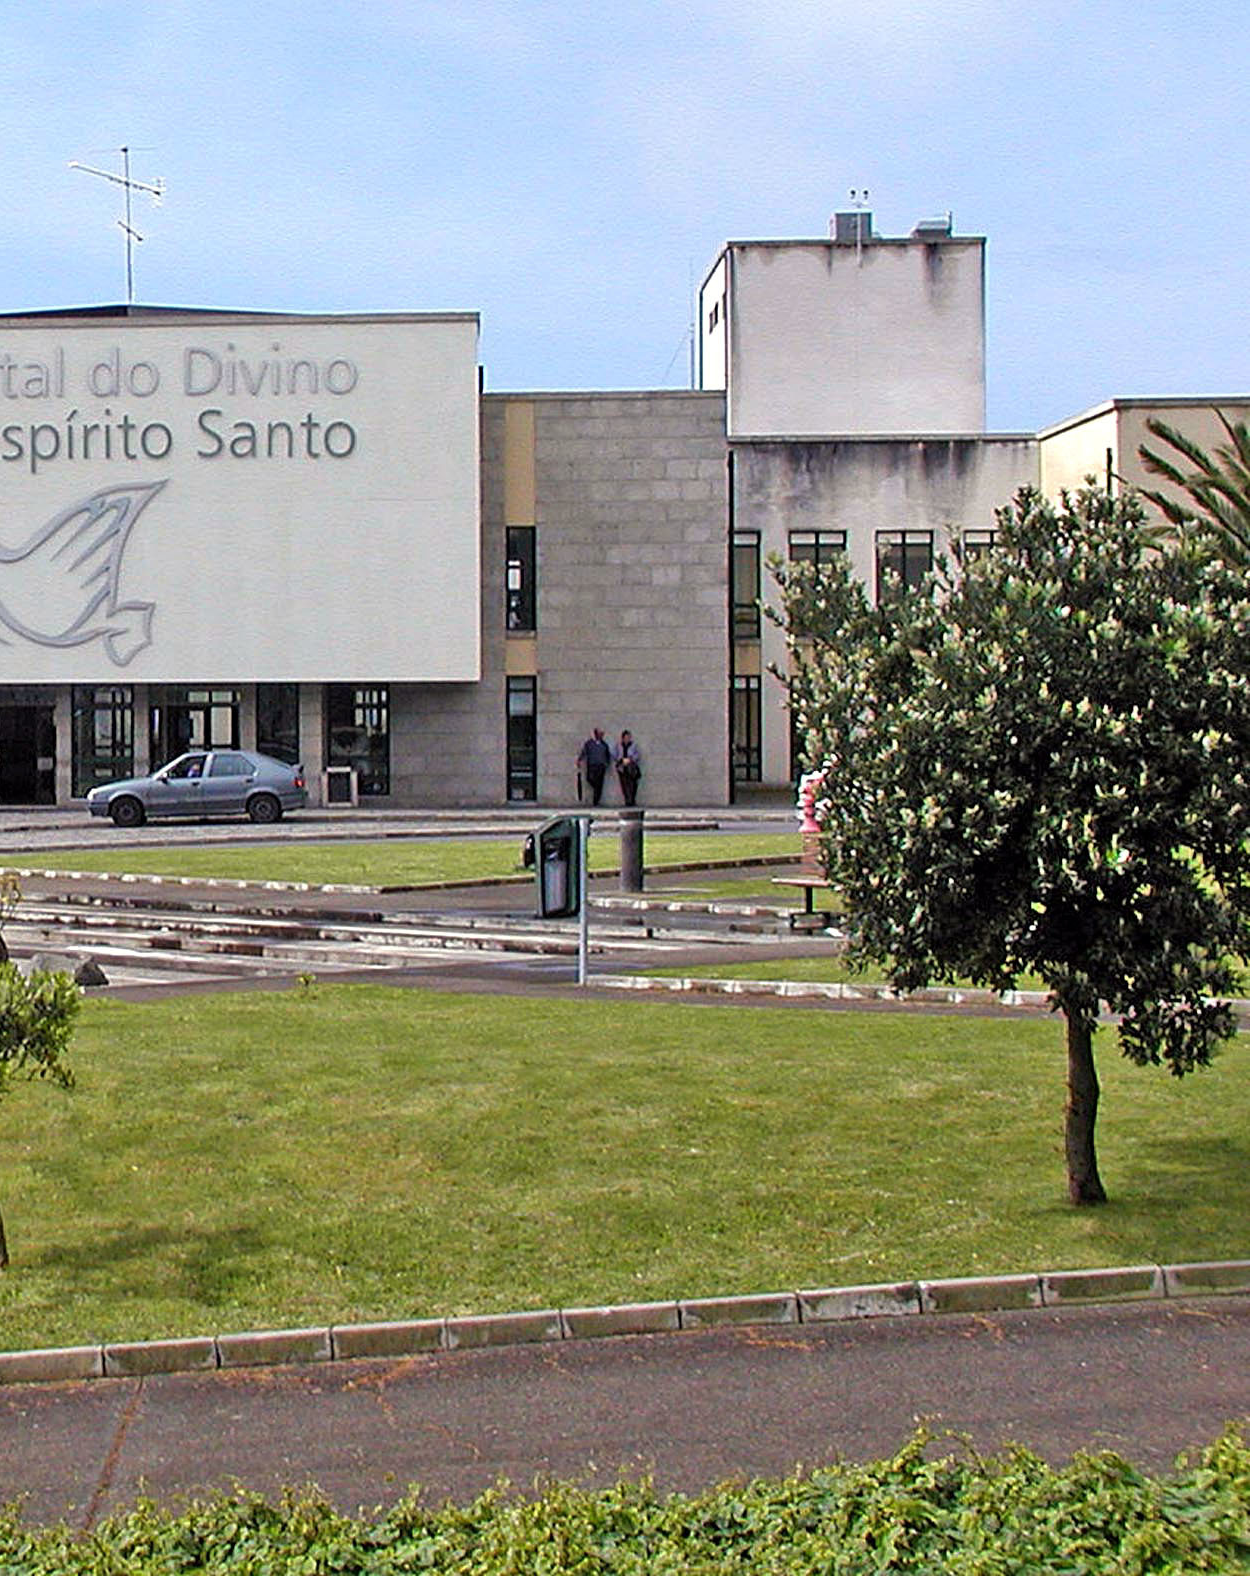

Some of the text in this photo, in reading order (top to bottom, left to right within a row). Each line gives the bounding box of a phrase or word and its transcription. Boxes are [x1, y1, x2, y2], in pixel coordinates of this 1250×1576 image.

[88, 346, 160, 398] do
[183, 342, 359, 397] Divino
[197, 408, 356, 459] Santo
